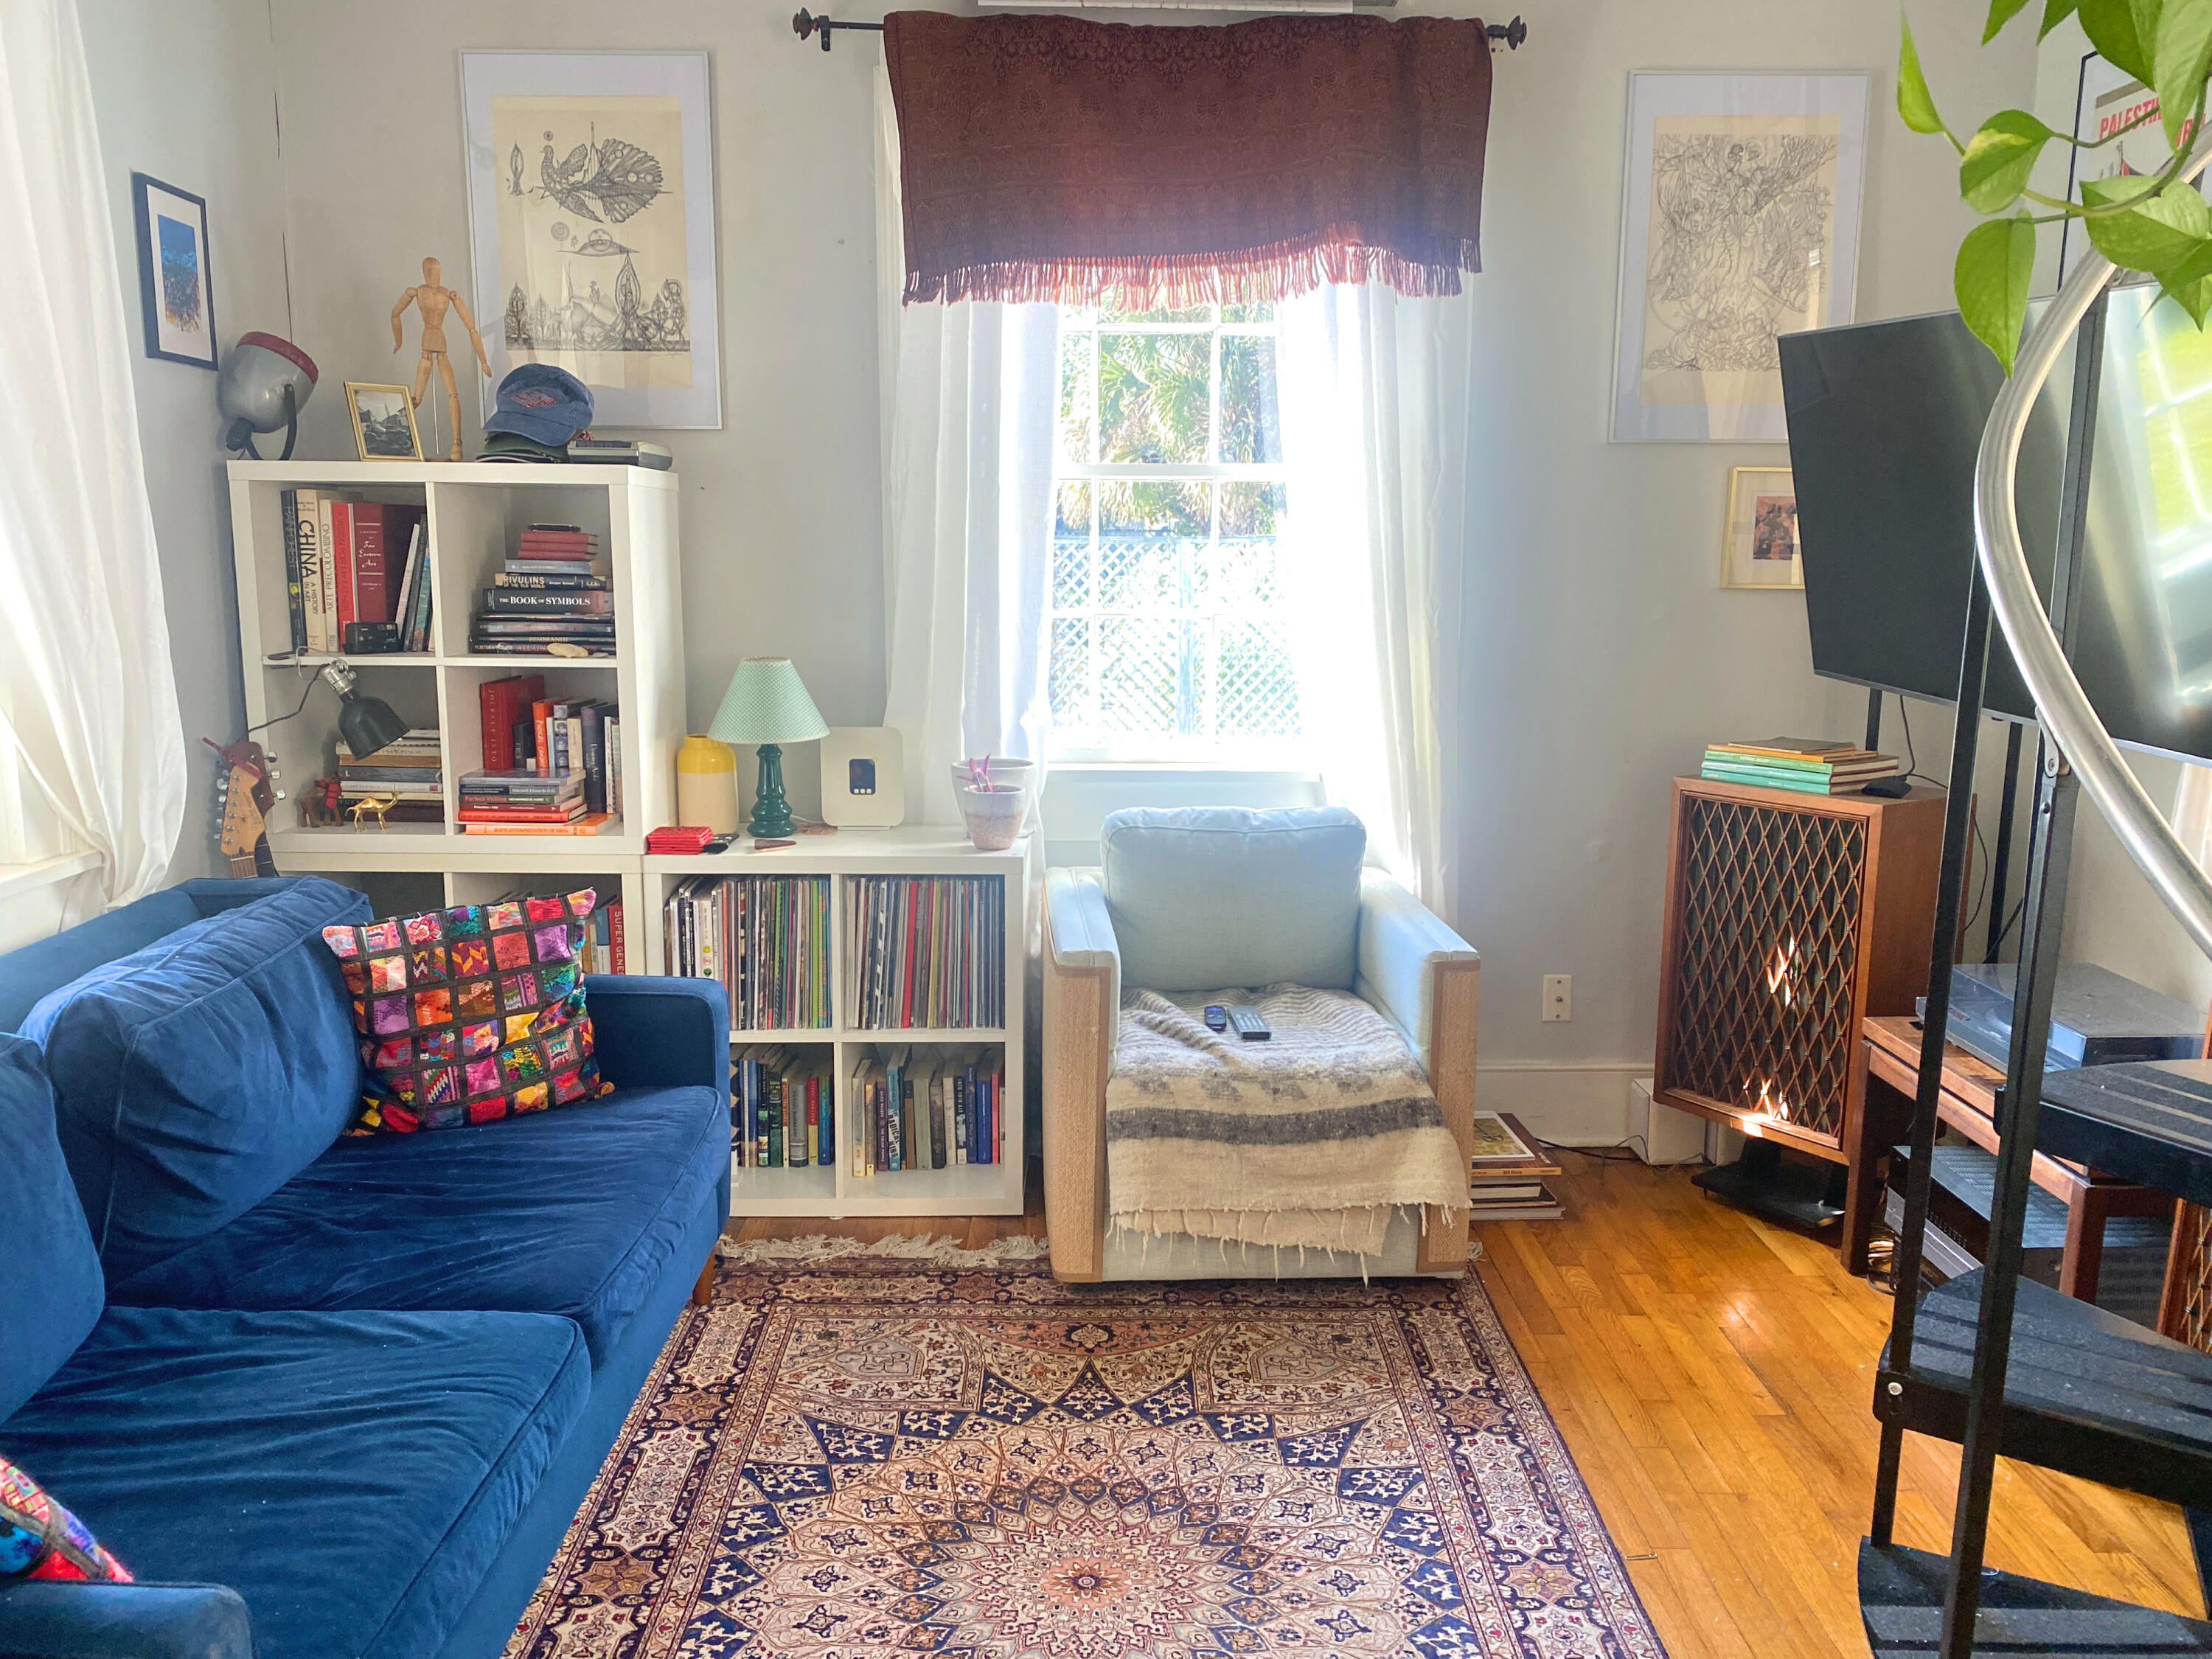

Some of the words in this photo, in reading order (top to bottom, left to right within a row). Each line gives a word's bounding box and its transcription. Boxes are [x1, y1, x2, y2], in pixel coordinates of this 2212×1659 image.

[299, 520, 317, 578] CHINA
[321, 524, 333, 588] PRECOLOMBINO
[504, 575, 545, 585] RIVULINS
[310, 589, 319, 615] HISTORY
[510, 596, 538, 605] BOOK
[545, 597, 591, 606] SYMBOLS
[614, 911, 623, 943] SUPER
[616, 945, 625, 975] GENES
[887, 1114, 900, 1144] RADICAL
[888, 1141, 899, 1158] KING
